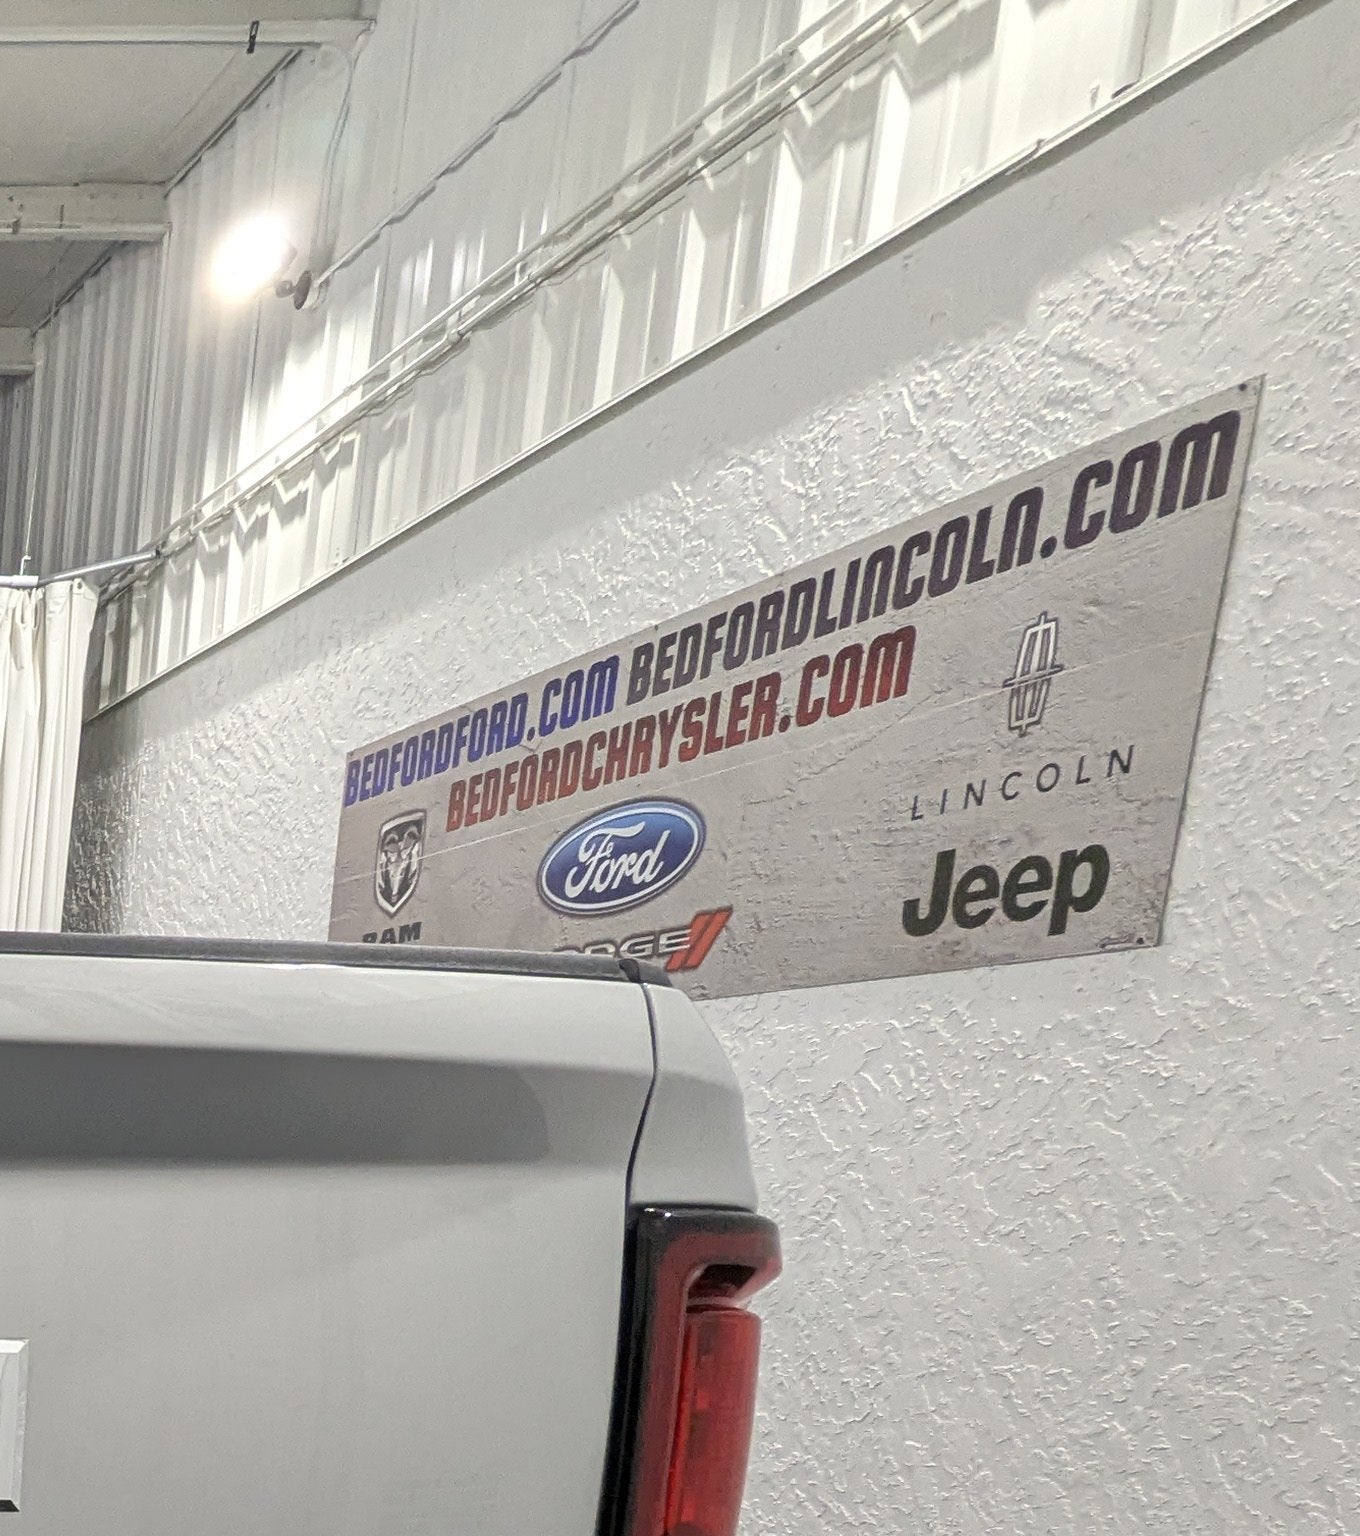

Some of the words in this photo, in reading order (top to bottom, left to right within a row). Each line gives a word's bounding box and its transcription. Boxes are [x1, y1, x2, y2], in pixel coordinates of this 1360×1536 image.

[345, 655, 619, 808] BEDFORDFORD.COM
[626, 409, 1241, 706] BEDFORDLINCOLN.COM
[446, 624, 917, 832] BEDFORDCHRYSLER.COM
[911, 745, 1135, 821] LINCOLN
[564, 821, 671, 898] Ford
[902, 843, 1111, 937] Jeep
